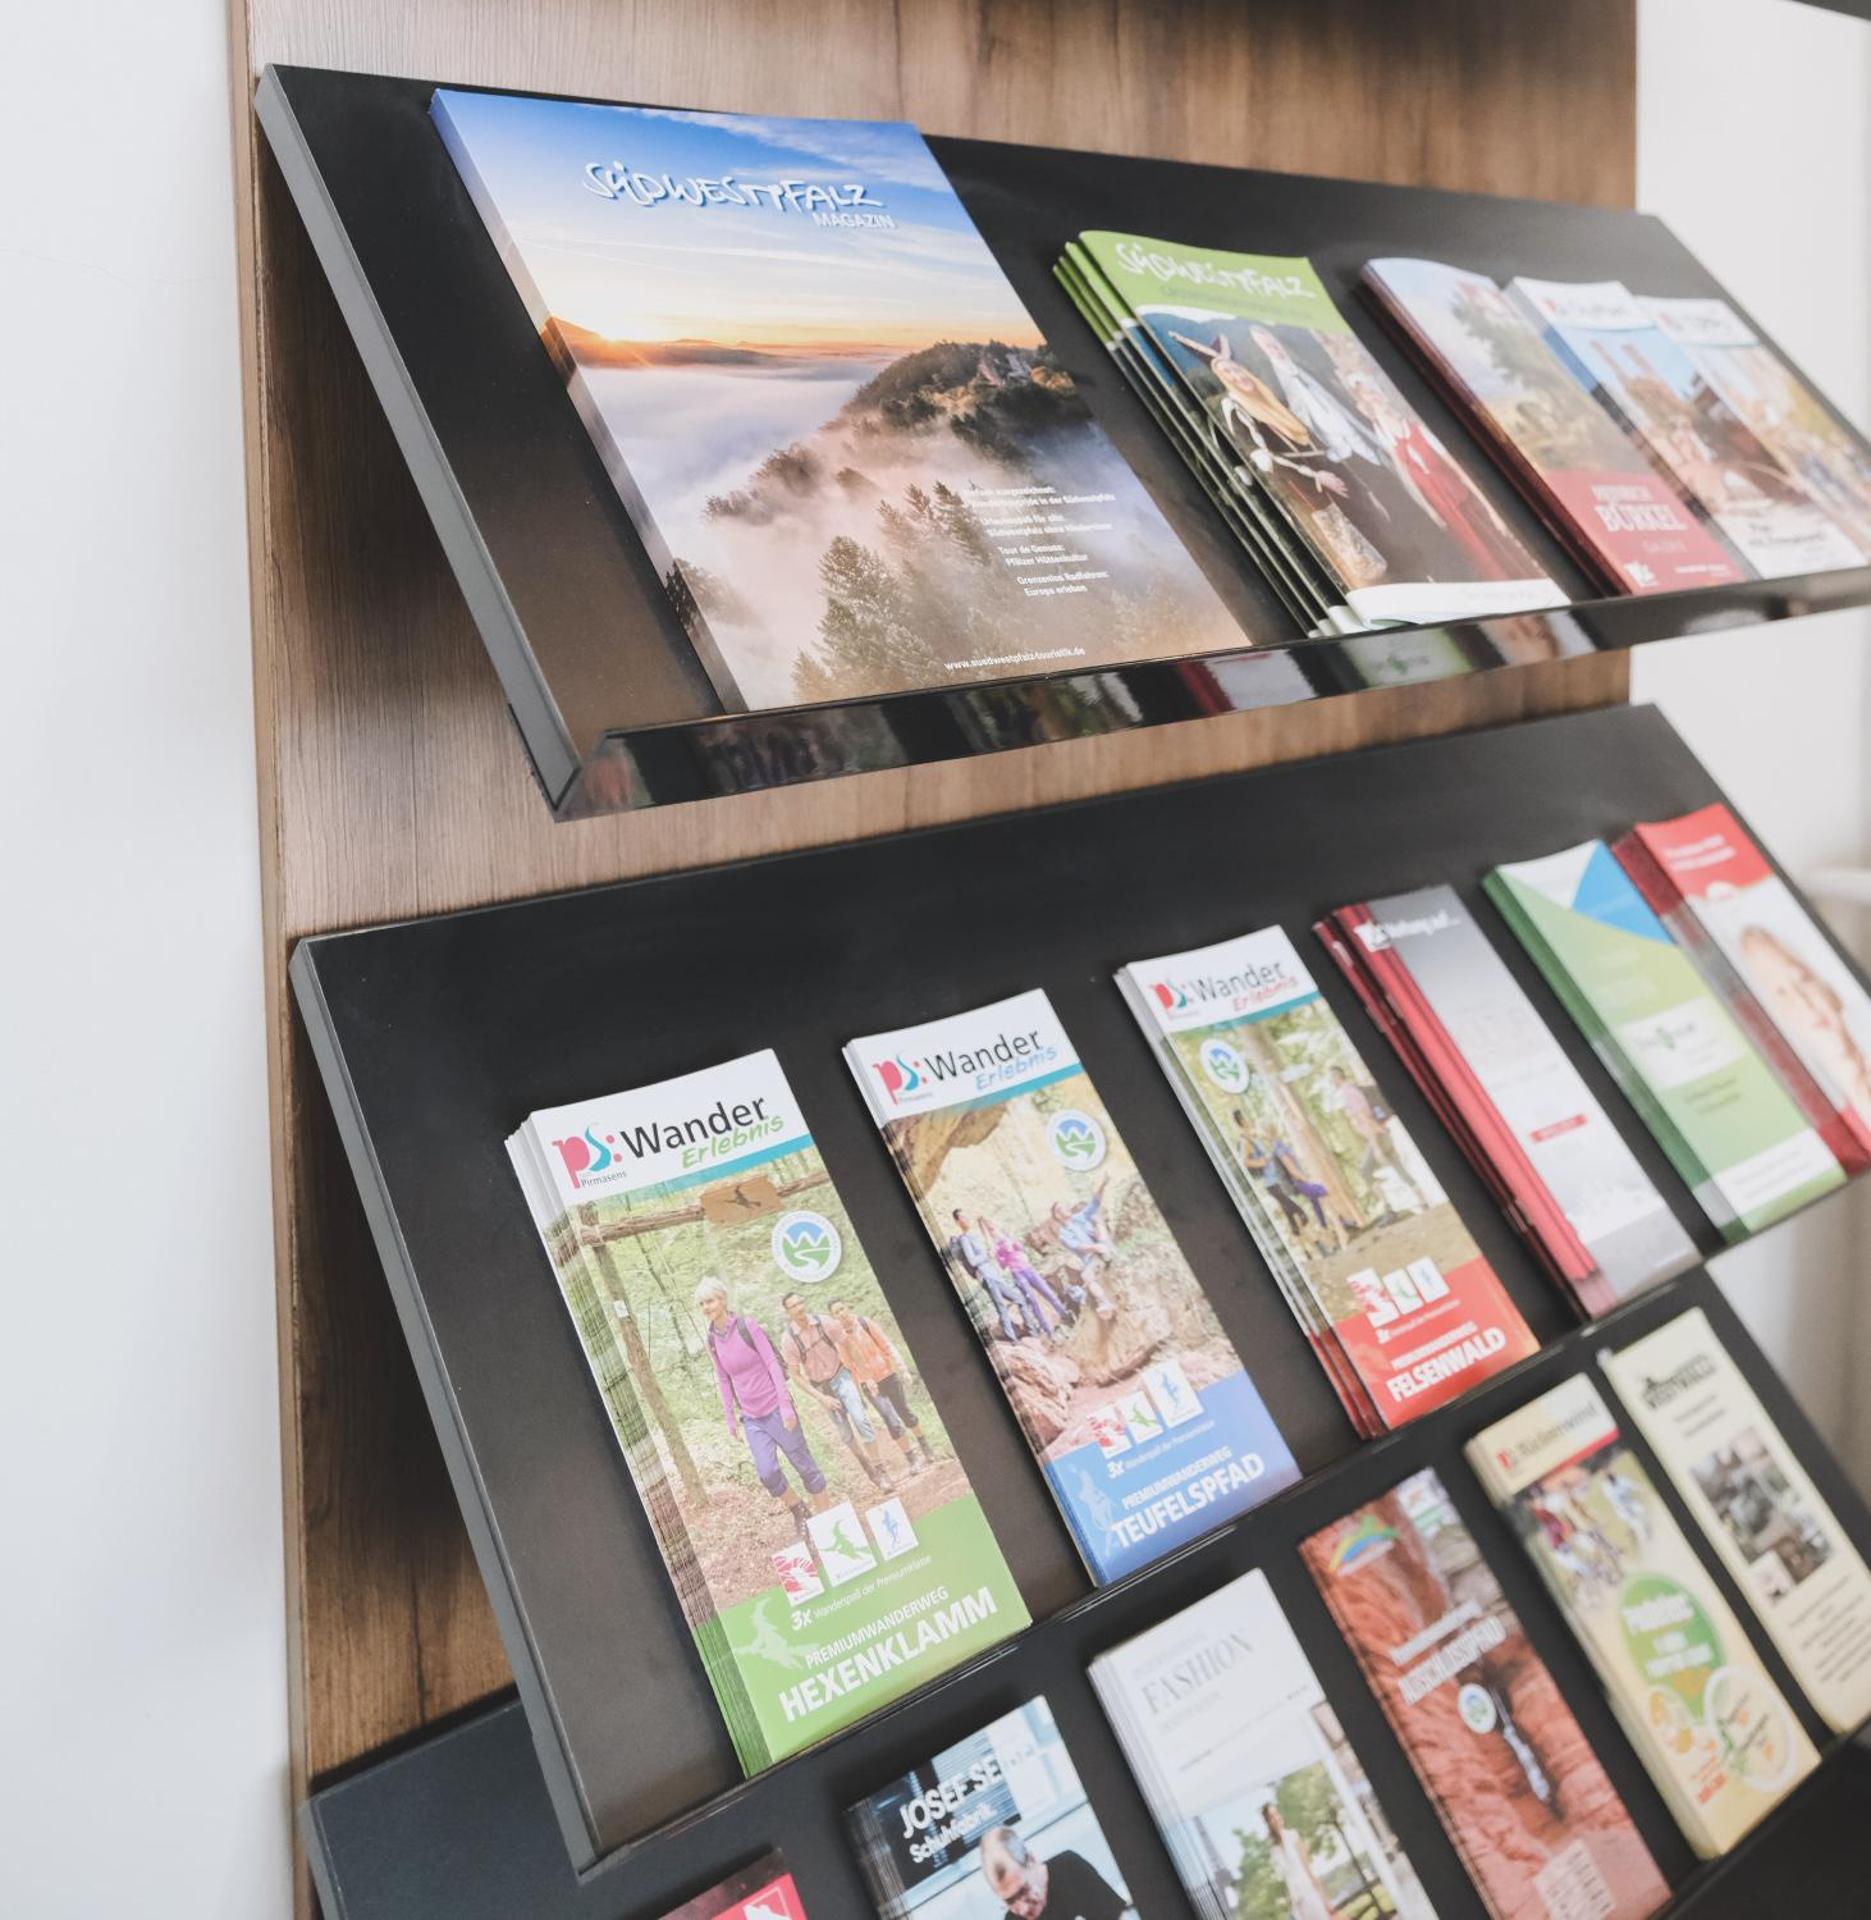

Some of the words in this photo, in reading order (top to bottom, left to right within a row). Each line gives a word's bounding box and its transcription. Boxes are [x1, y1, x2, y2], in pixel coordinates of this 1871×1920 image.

[584, 160, 886, 212] SÜDWESTPFALZ
[811, 211, 897, 230] MAGAZIN
[1024, 586, 1055, 597] Europa
[1190, 962, 1286, 1002] Wander
[925, 1030, 1040, 1081] Wander
[976, 1045, 1057, 1091] Erlebnis
[620, 1096, 768, 1159] Wander
[682, 1114, 785, 1170] Erlebnis
[581, 1170, 626, 1187] Pirmasens
[1386, 1327, 1506, 1402] FELSENWALD
[1110, 1453, 1265, 1549] TEUFELSPFAD
[791, 1609, 812, 1631] 3x
[805, 1585, 949, 1669] PREMIUMWANDERWEG
[778, 1586, 998, 1722] HEXENKLAMM
[1142, 1632, 1253, 1714] FASHION
[900, 1772, 968, 1839] JOSEF
